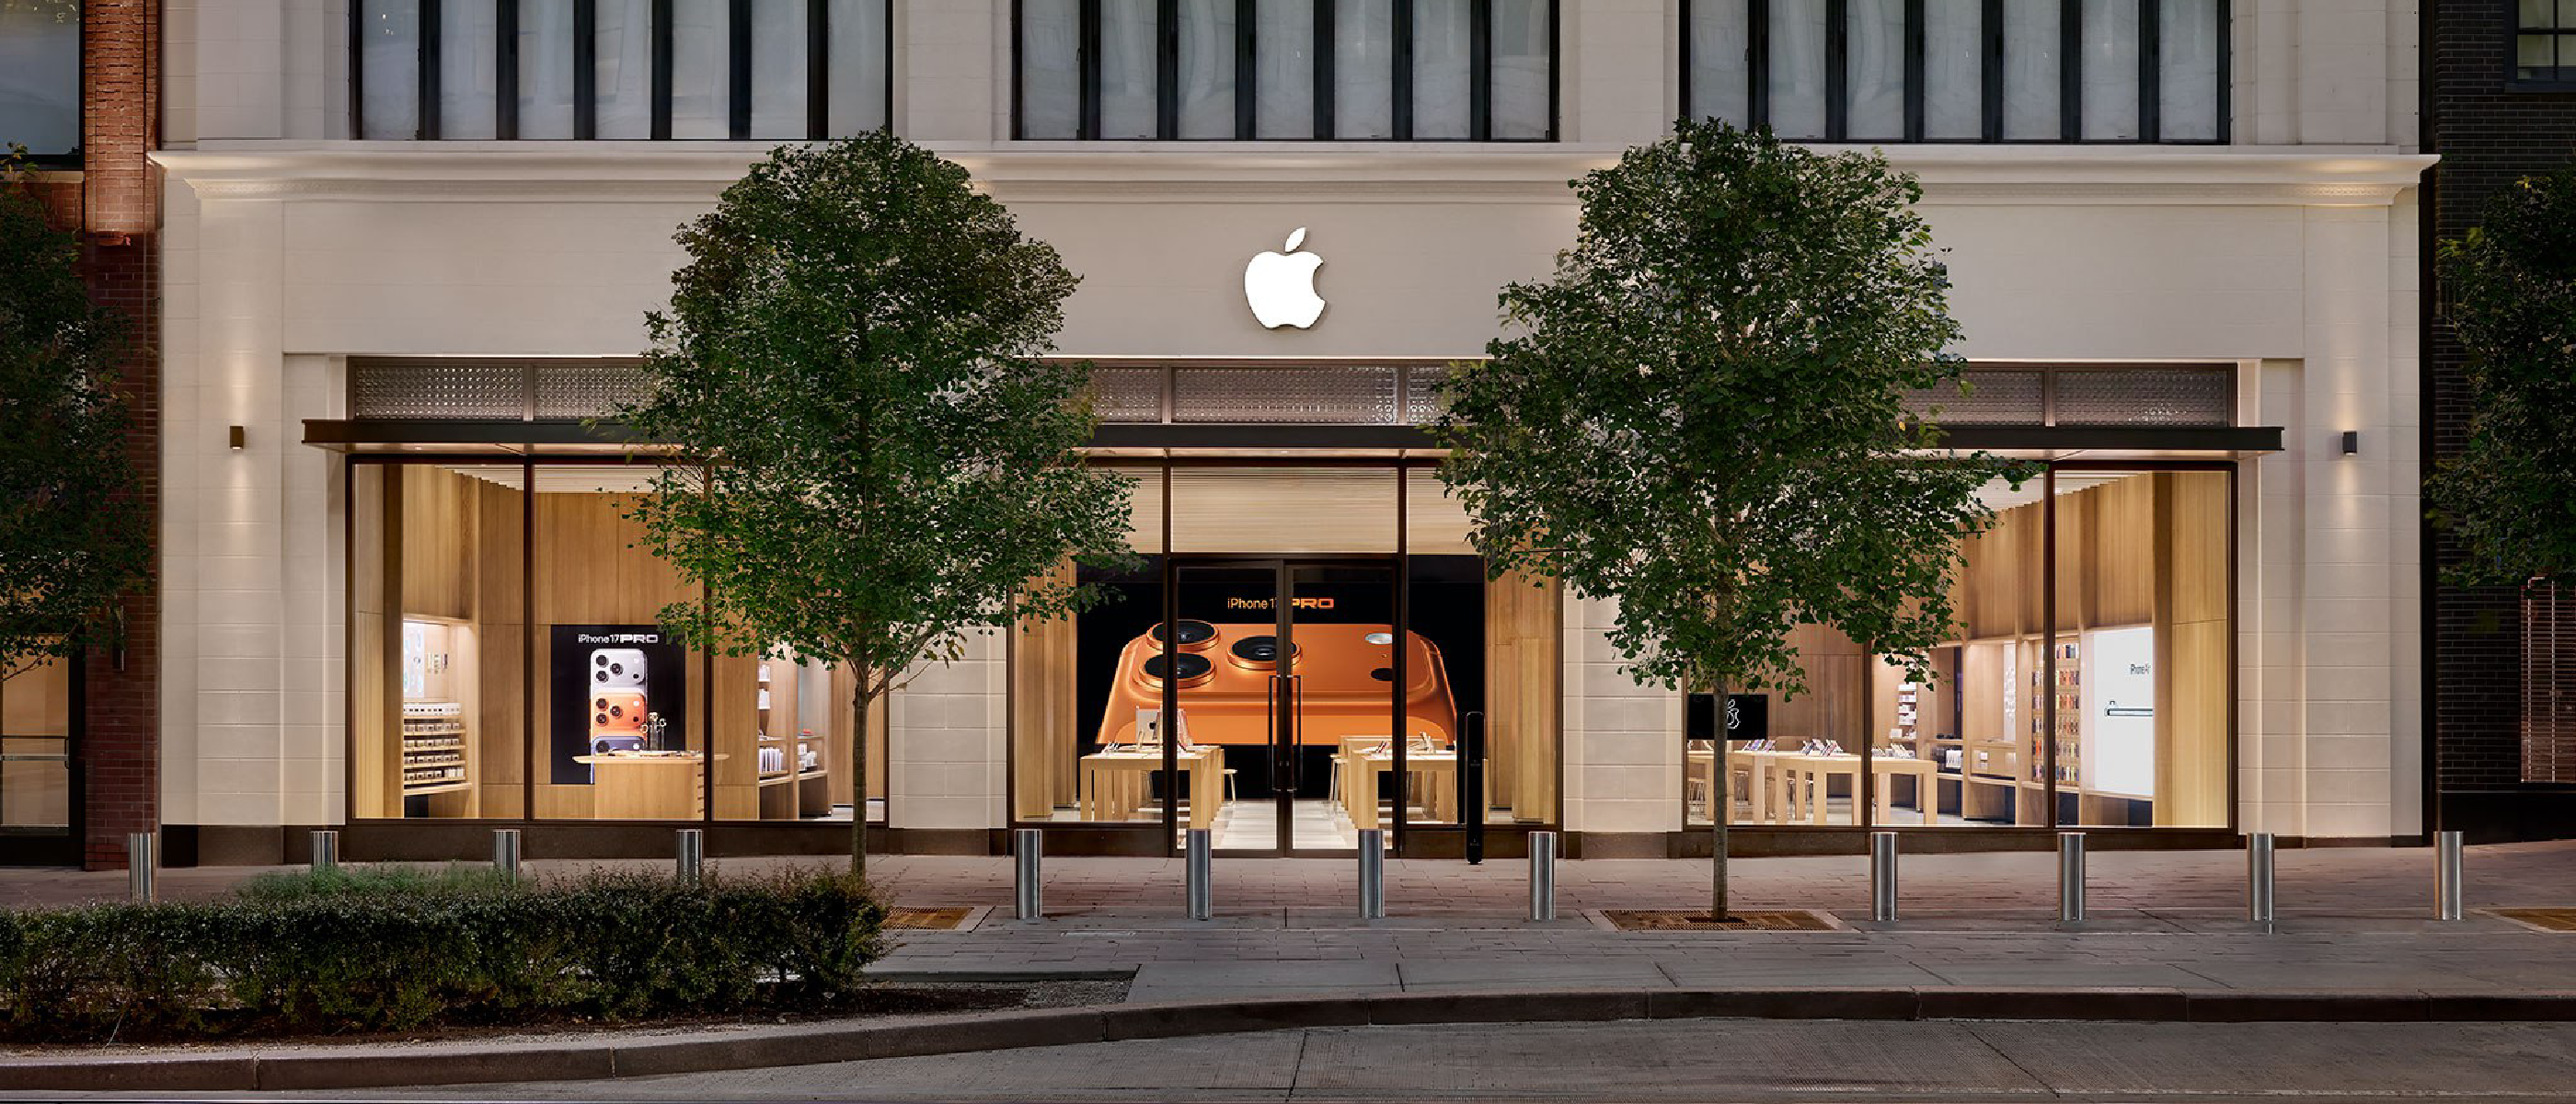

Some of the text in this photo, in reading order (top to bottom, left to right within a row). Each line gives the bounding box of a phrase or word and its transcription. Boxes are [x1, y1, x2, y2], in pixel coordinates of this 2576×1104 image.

[1227, 597, 1268, 609] iPhone
[578, 634, 658, 643] iPhone 17 PRO
